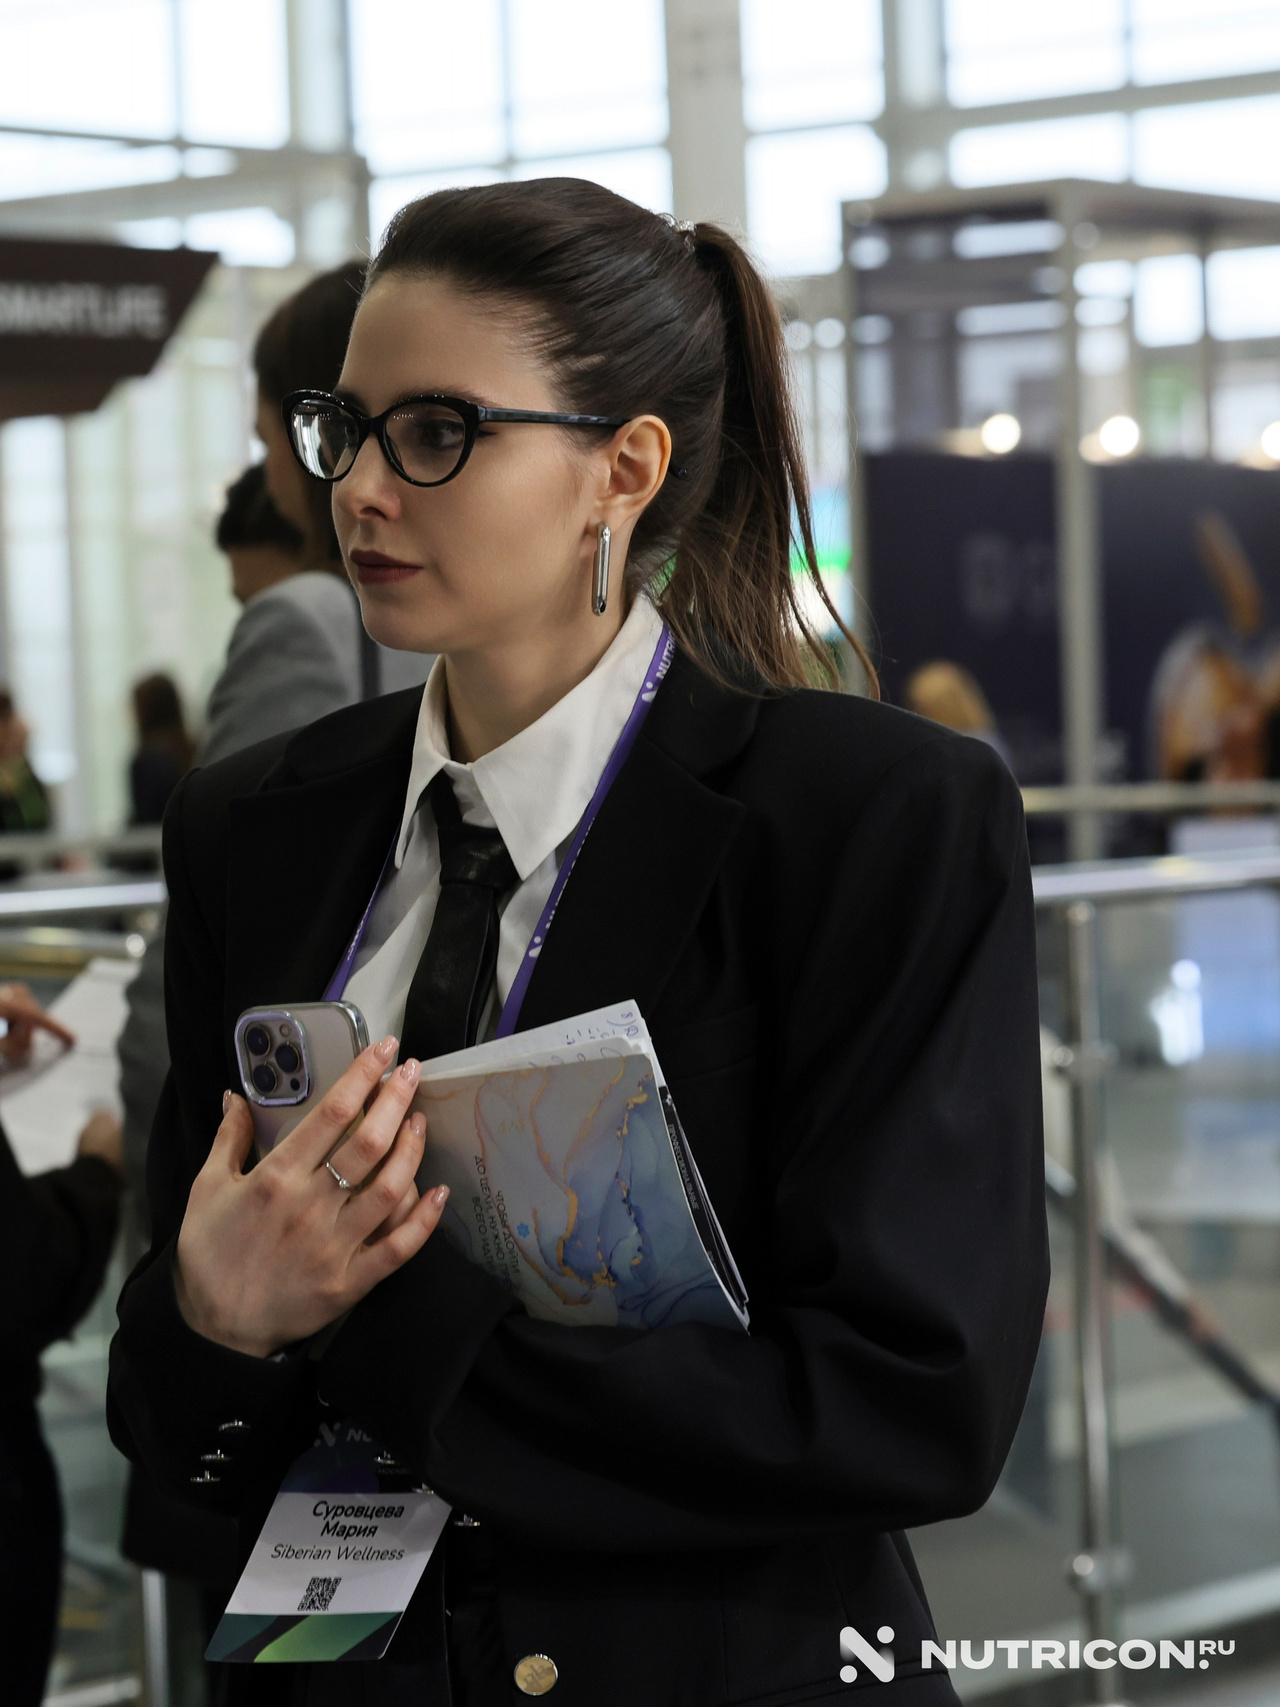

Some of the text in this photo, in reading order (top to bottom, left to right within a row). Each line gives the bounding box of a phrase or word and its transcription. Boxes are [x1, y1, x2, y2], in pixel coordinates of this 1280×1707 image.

[472, 1196, 487, 1235] ВСЕГО
[474, 1155, 486, 1175] ДО
[489, 1215, 505, 1260] НУЖНО
[496, 1190, 520, 1274] ЧТОБЫ ДОЙТИ
[312, 1501, 405, 1520] Суровцева
[320, 1521, 378, 1541] Мария
[270, 1543, 405, 1561] Siberian Wellness
